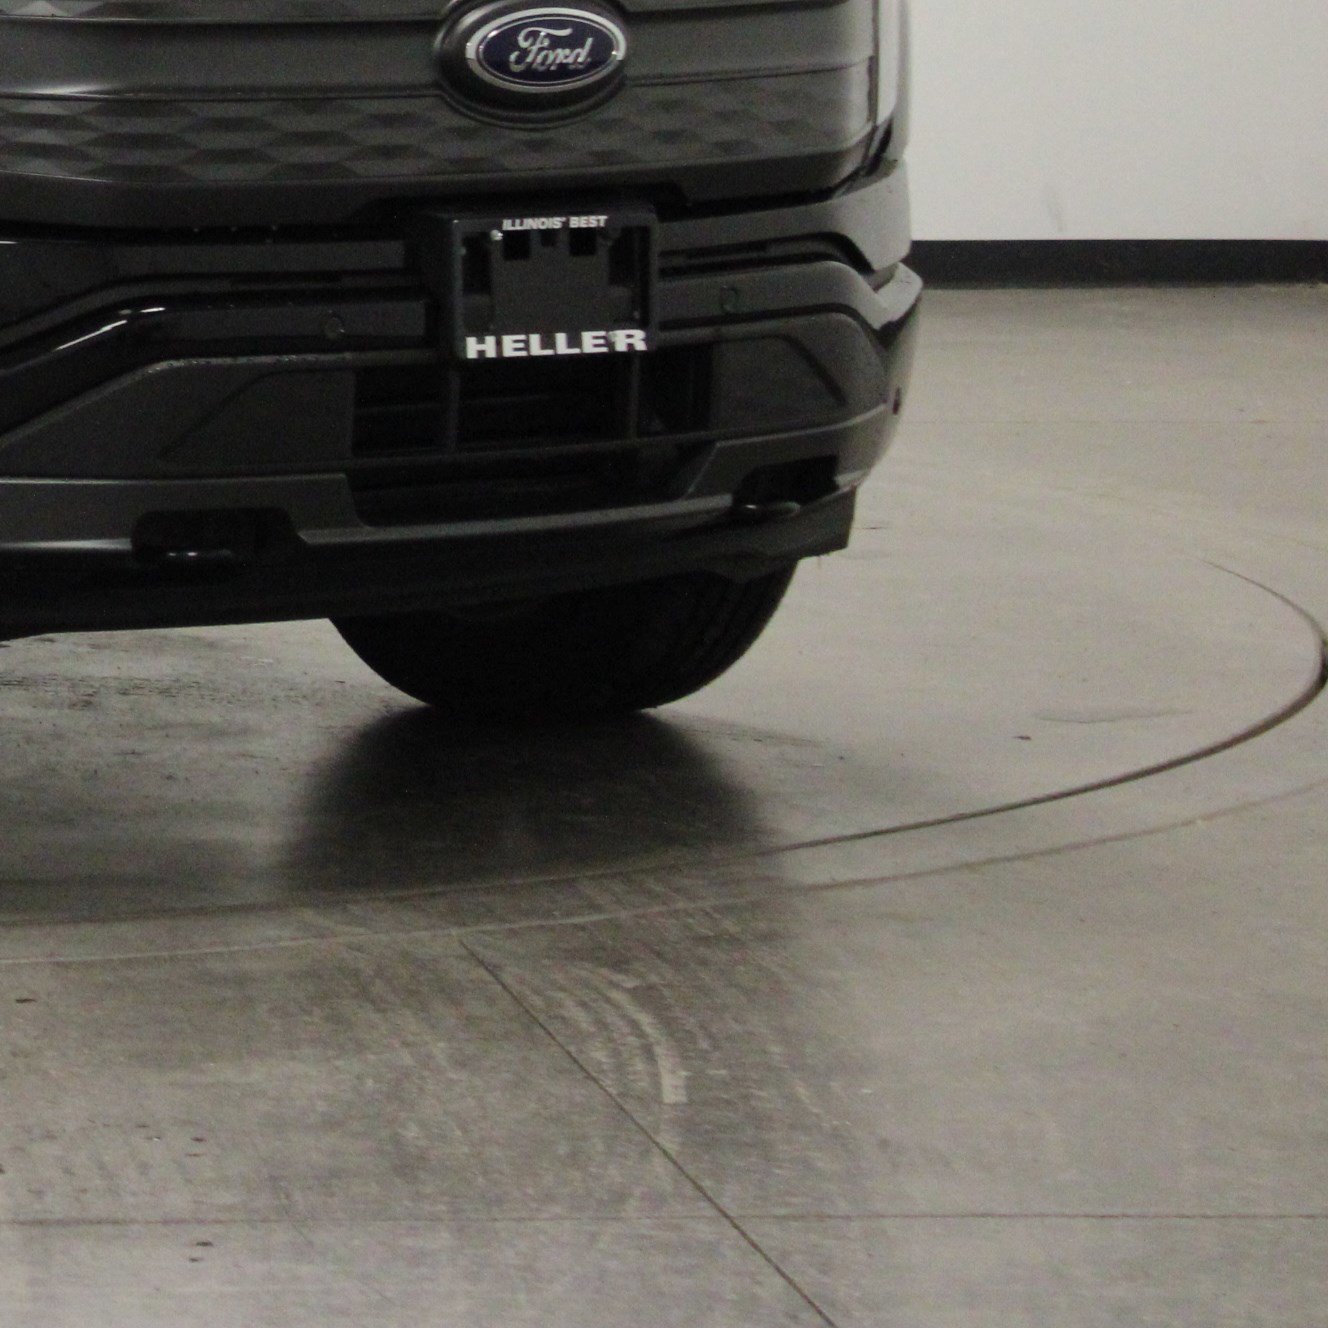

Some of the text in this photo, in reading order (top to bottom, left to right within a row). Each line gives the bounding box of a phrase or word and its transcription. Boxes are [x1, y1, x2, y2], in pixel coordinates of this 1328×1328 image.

[508, 26, 594, 73] Ford
[569, 215, 608, 228] BEST
[465, 329, 648, 359] HELLER
